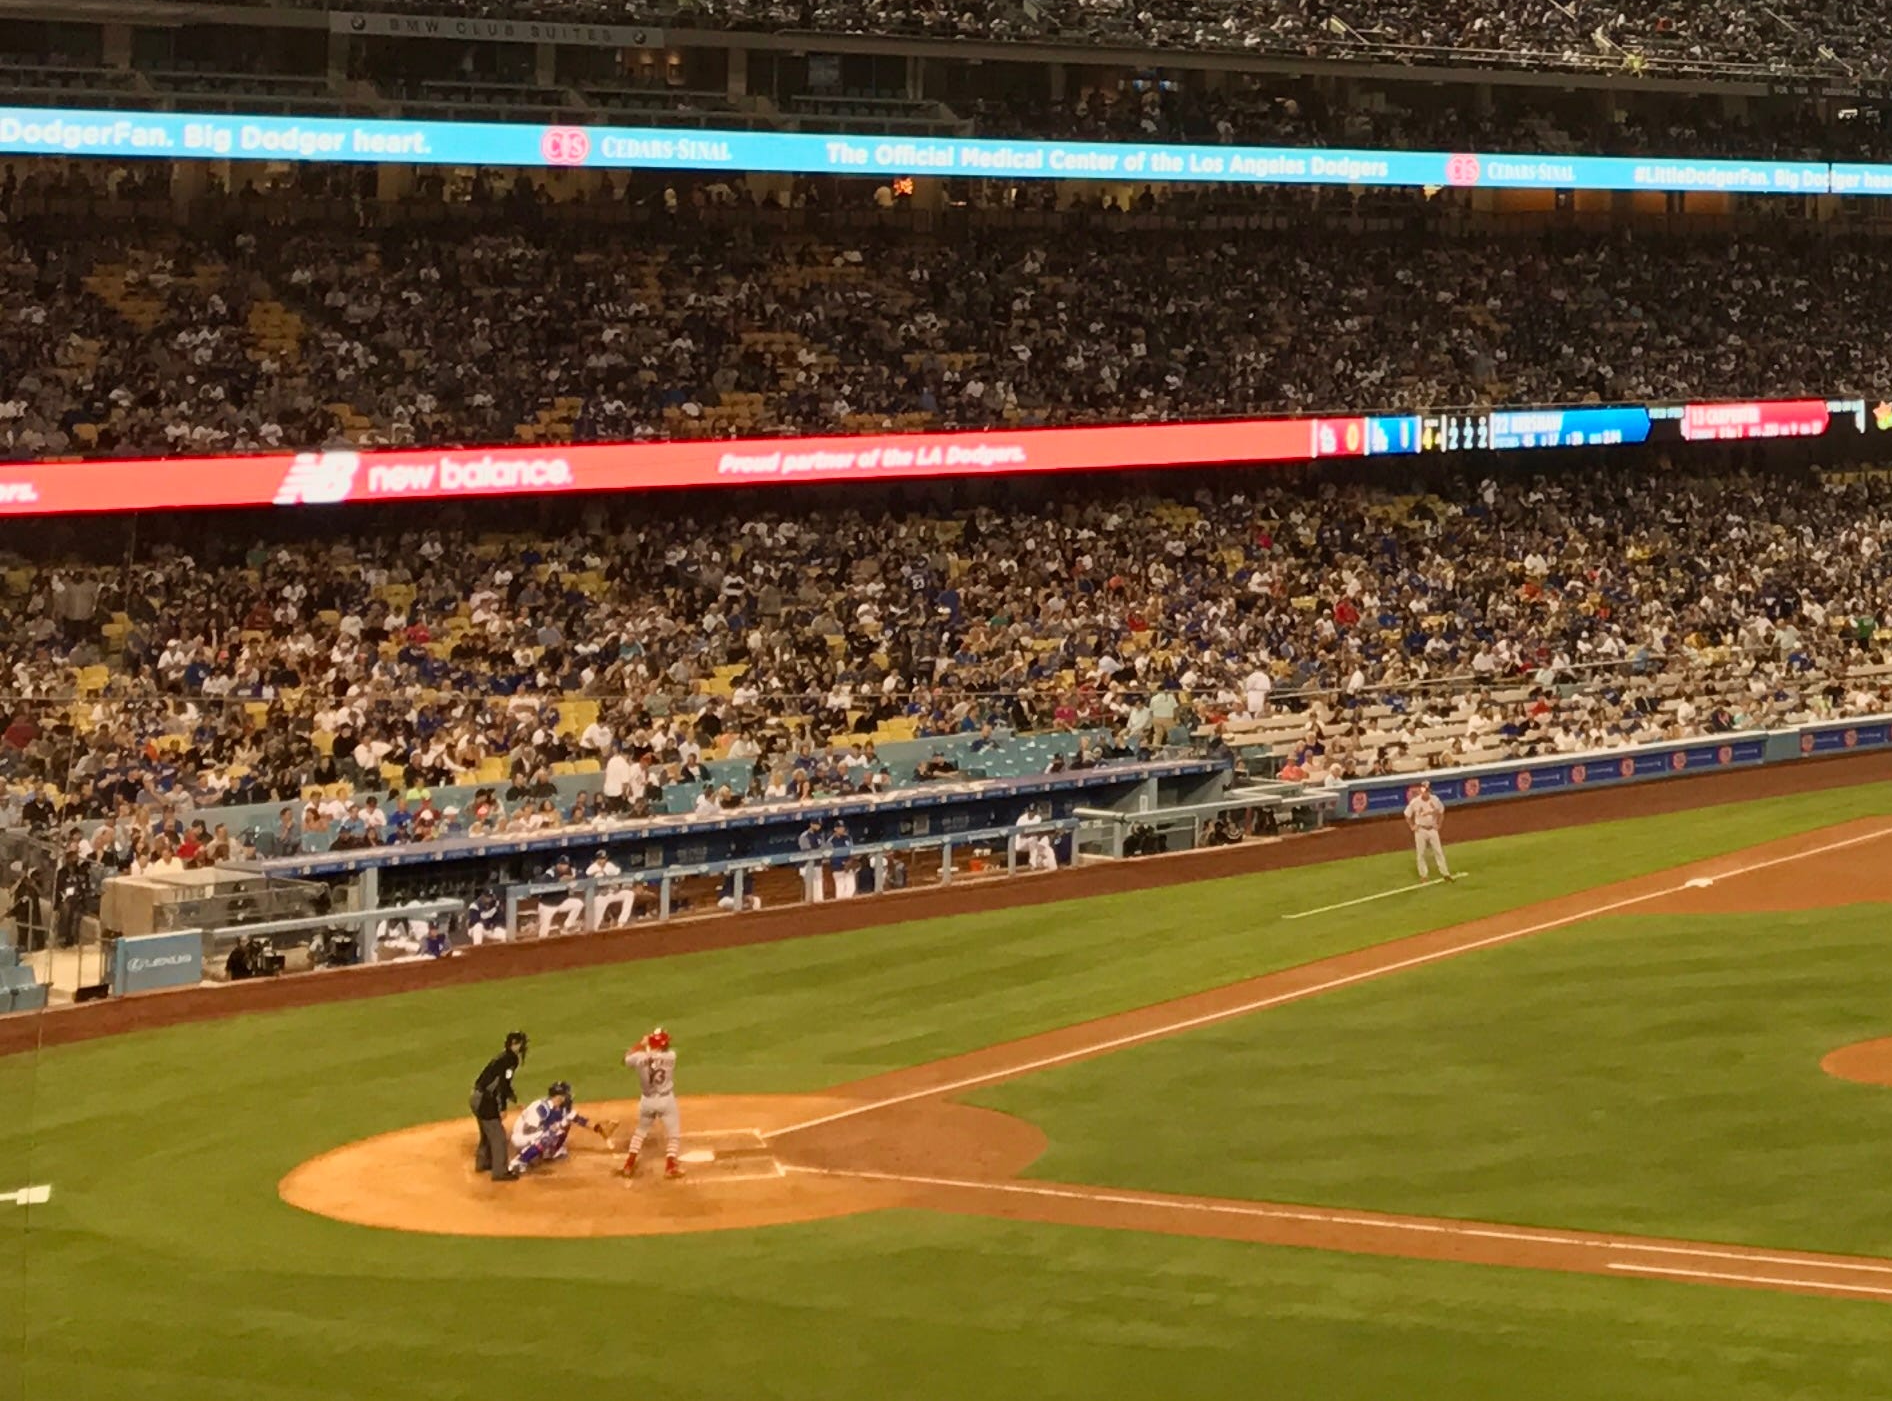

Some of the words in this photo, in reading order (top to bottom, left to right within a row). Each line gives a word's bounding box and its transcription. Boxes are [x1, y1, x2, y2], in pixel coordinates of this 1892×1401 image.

[389, 19, 439, 33] BMW
[457, 22, 515, 37] CLUB
[531, 25, 612, 41] SUITES
[183, 123, 232, 153] Big
[240, 125, 345, 156] Dodger
[353, 129, 432, 155] heart.
[826, 142, 868, 165] The
[874, 143, 954, 167] Official
[960, 145, 1044, 170] Medical
[1049, 149, 1119, 172] Center
[1123, 150, 1147, 173] of
[1150, 152, 1184, 174] the
[1188, 153, 1224, 175] Los
[1229, 154, 1306, 179] Angeles
[1310, 155, 1389, 180] Dodgers
[1634, 164, 1770, 188] #LittleDodgerFan.
[1774, 169, 1798, 190] Big
[1802, 170, 1862, 191] Dodger
[1345, 422, 1360, 451] 0
[1448, 426, 1459, 450] 2
[1463, 426, 1474, 449] 2
[1477, 425, 1488, 449] 2
[717, 452, 781, 475] Proud
[781, 451, 855, 475] partner
[857, 449, 881, 470] of
[881, 447, 914, 468] the
[915, 447, 943, 467] LA
[368, 462, 436, 493] new
[144, 953, 192, 968] LEXUS
